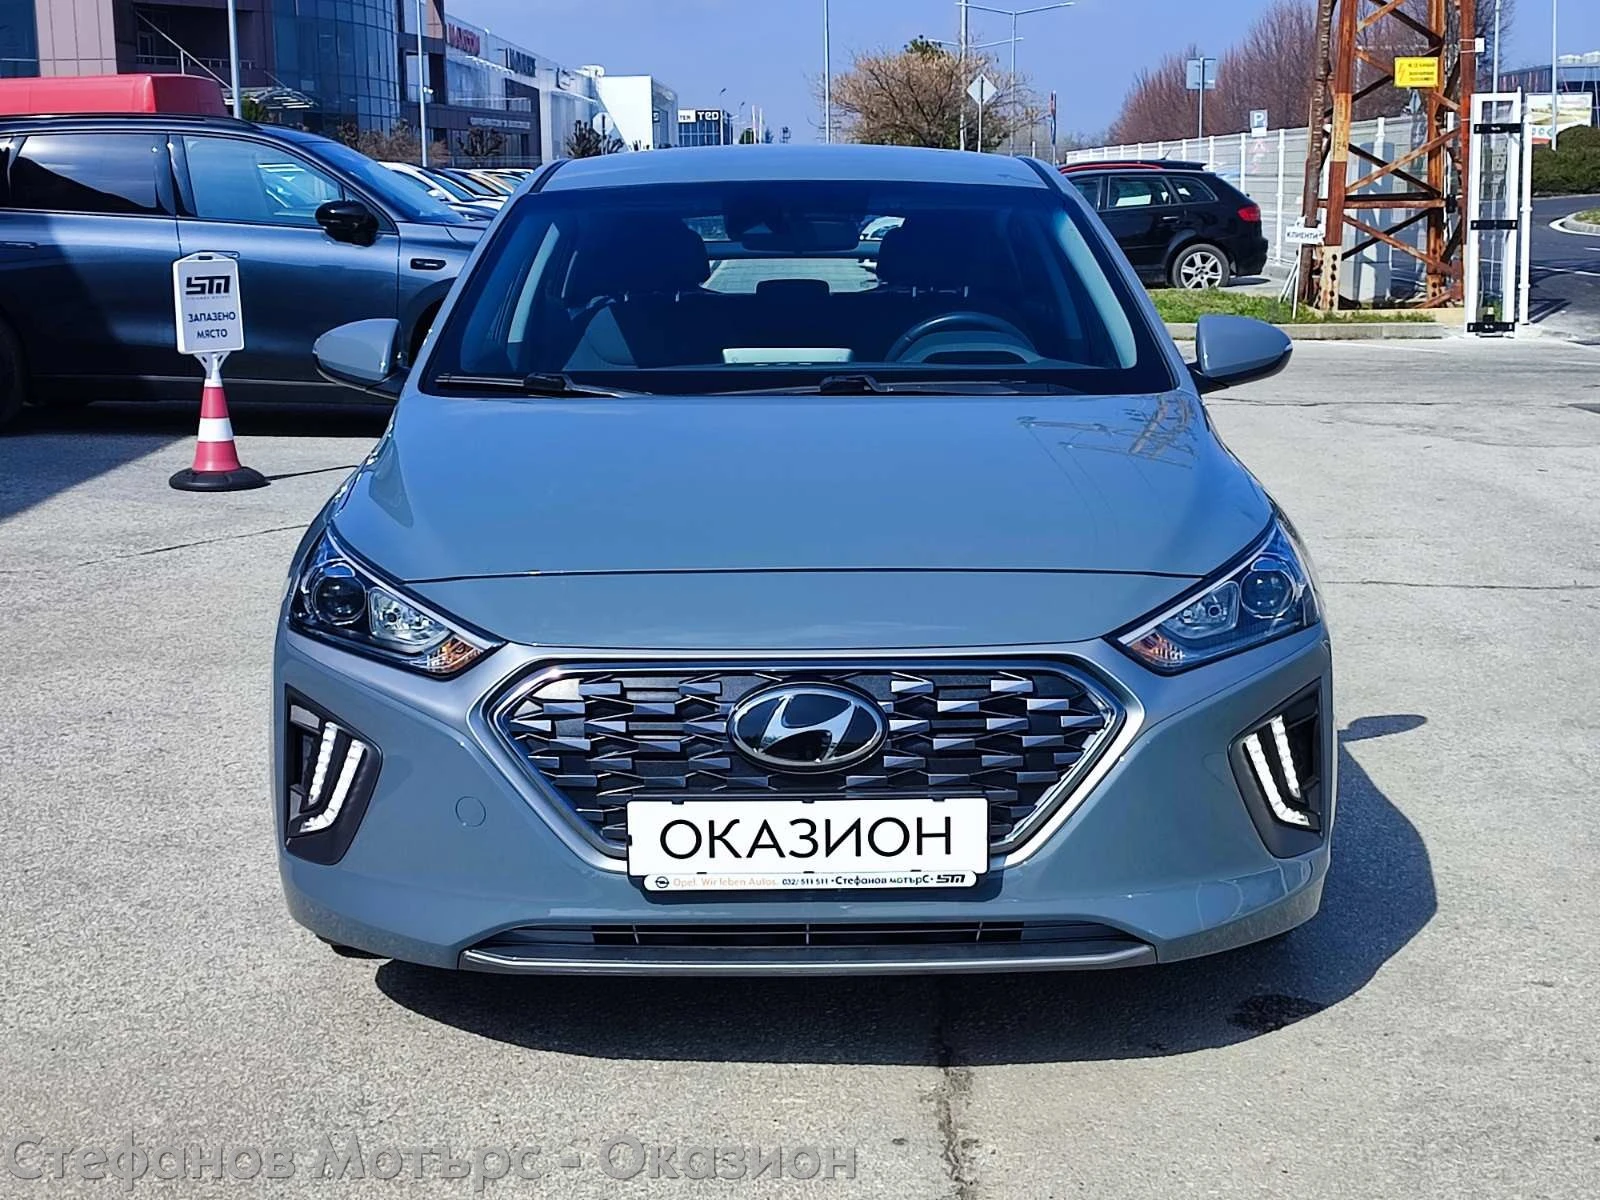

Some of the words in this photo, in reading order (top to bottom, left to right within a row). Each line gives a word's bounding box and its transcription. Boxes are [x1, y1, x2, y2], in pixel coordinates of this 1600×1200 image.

[188, 312, 236, 323] ЗАПАЗЕНО
[196, 329, 228, 339] МЯСТО
[660, 816, 951, 859] ОКАЗИОН
[720, 878, 744, 886] leben
[816, 877, 828, 885] 511
